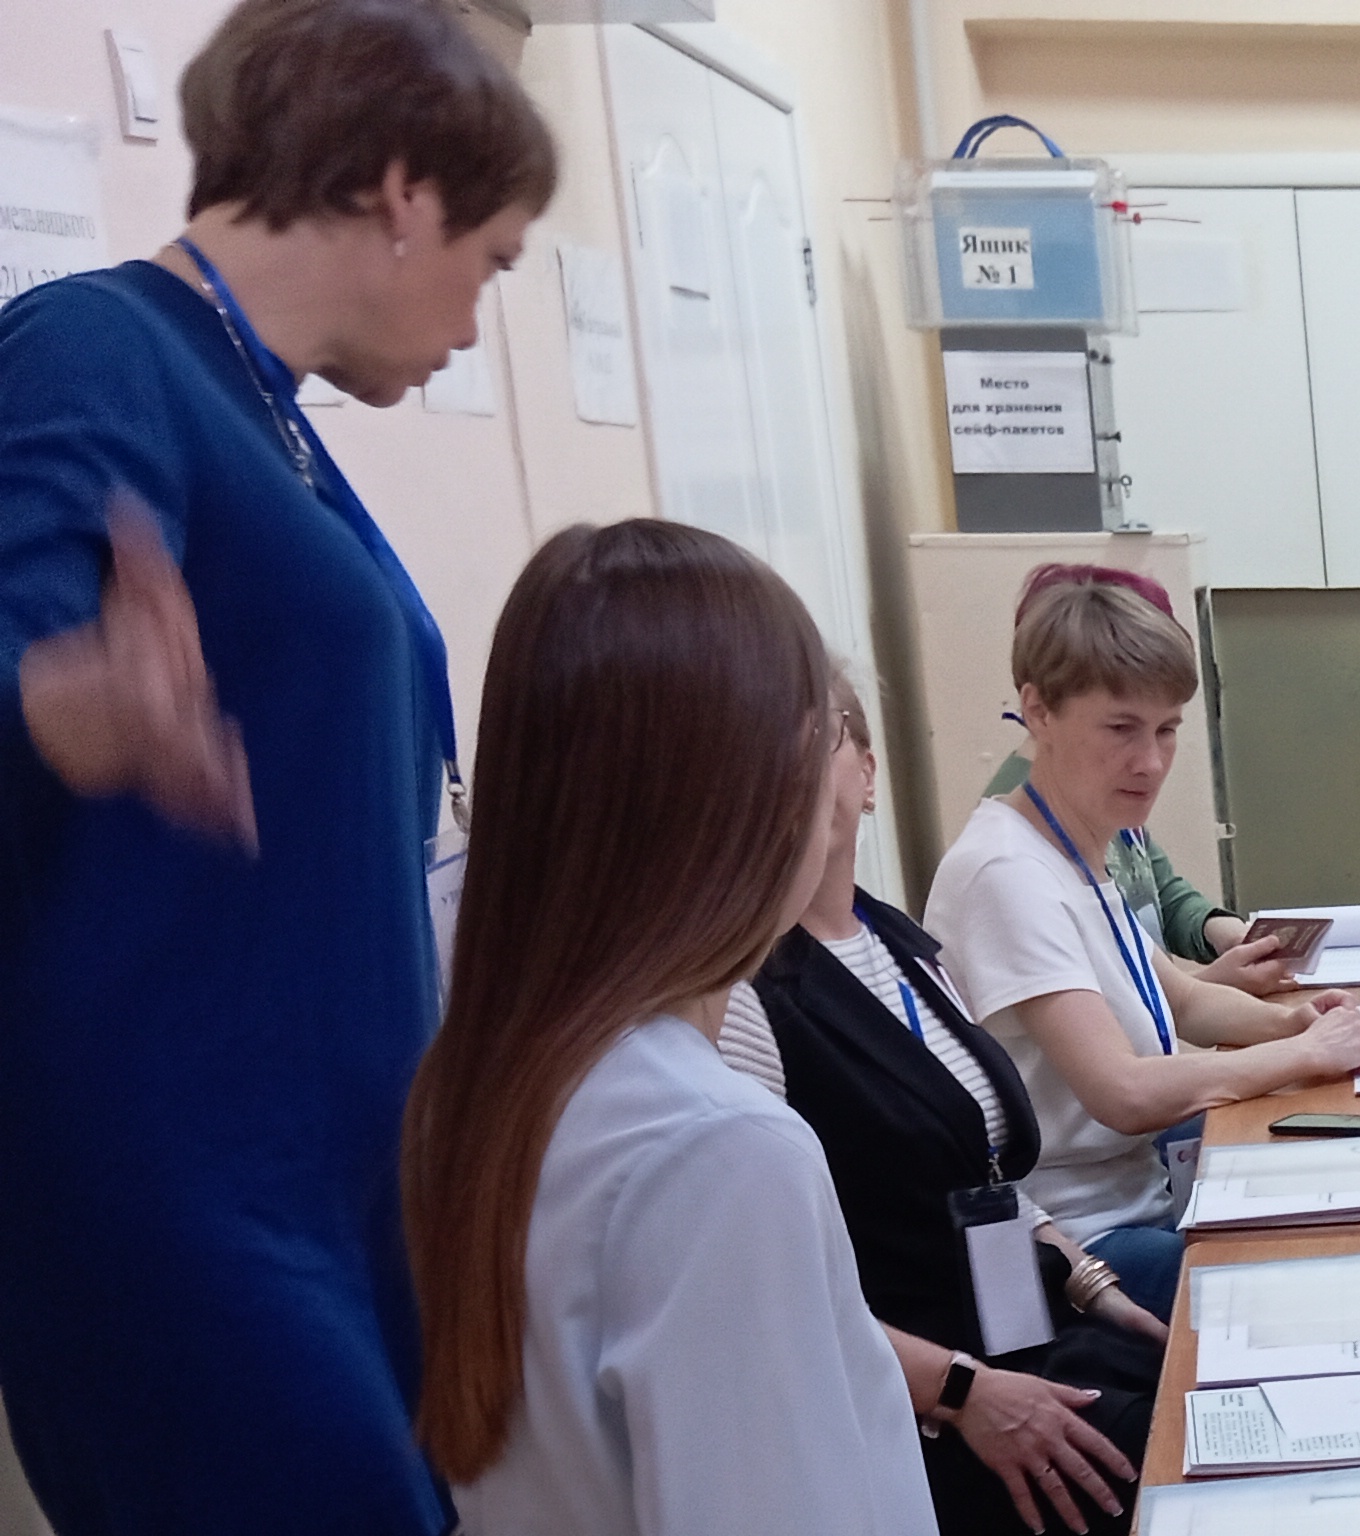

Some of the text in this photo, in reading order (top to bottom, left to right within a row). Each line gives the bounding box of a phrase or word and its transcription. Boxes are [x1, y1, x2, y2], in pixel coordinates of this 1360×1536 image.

[962, 234, 1030, 255] Ящик
[976, 265, 1017, 284] № 1
[980, 377, 1030, 390] Место
[952, 403, 1063, 416] для хранения
[953, 423, 1065, 437] сейф-пакетов
